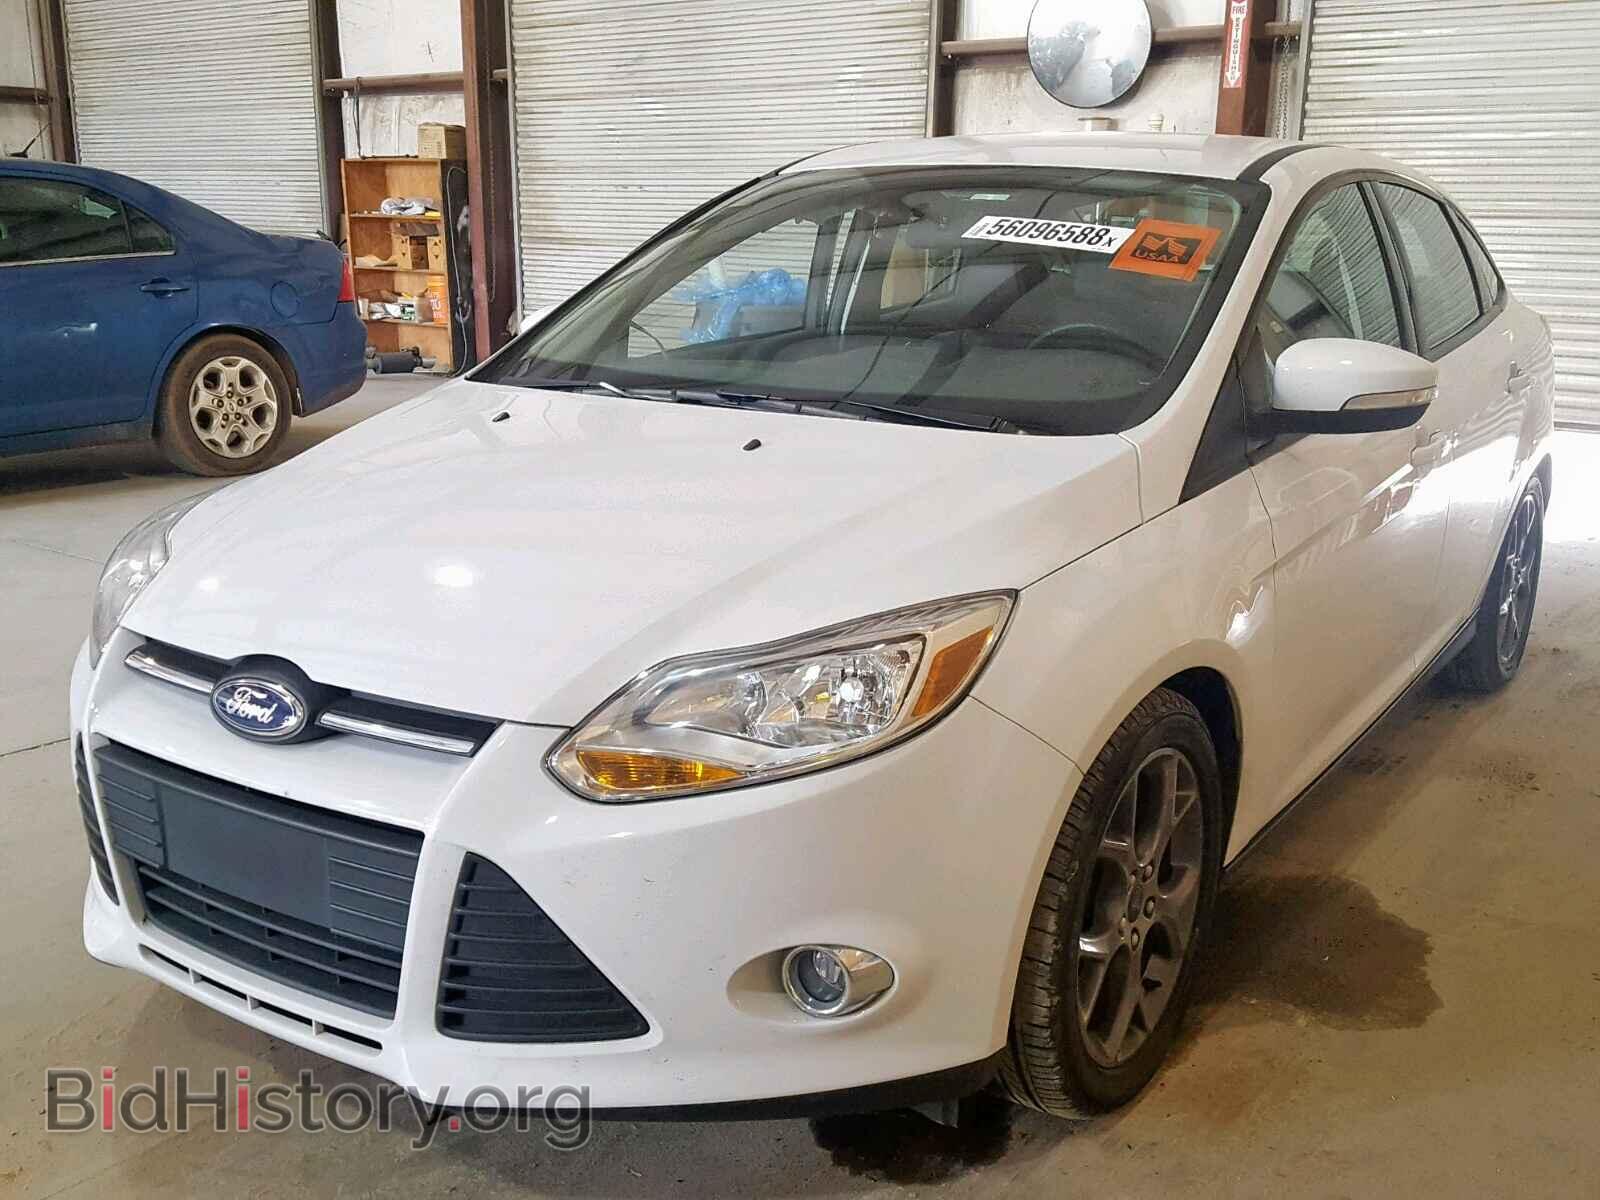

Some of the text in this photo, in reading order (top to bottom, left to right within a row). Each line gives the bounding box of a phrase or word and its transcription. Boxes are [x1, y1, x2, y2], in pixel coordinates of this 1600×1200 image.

[1232, 5, 1246, 15] FIRE
[1134, 249, 1180, 263] USAA
[226, 686, 278, 724] Ford
